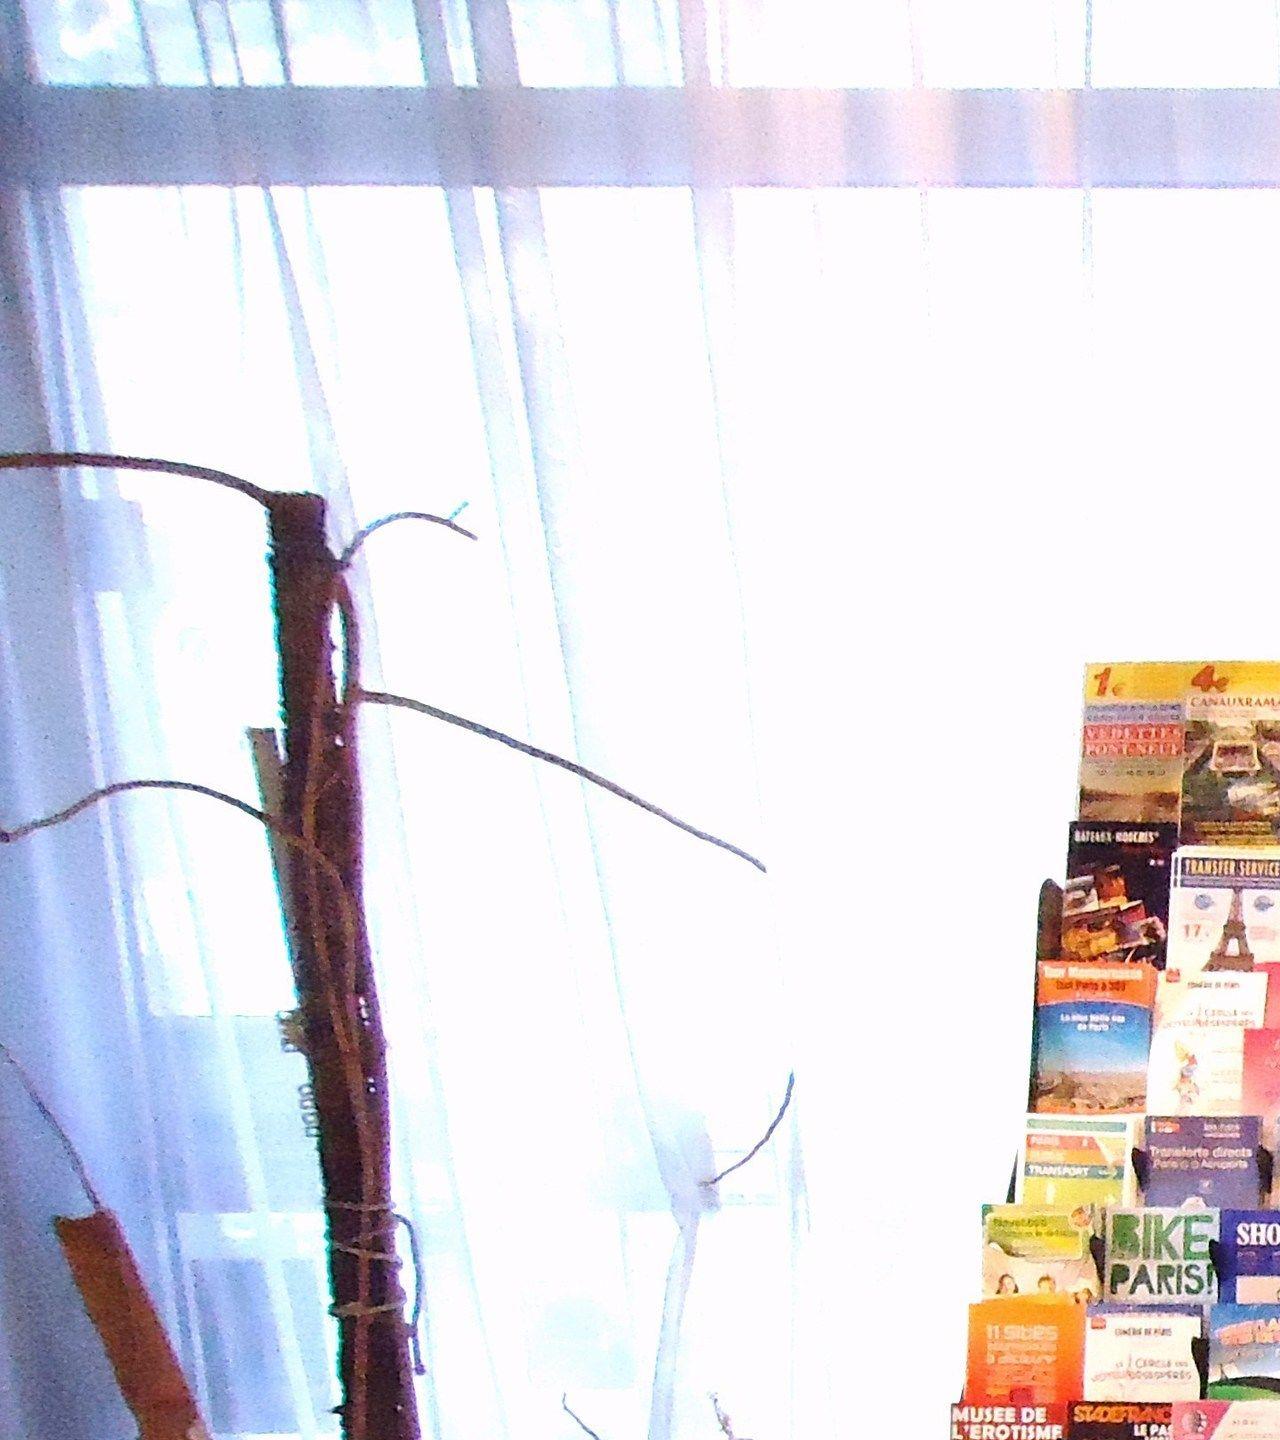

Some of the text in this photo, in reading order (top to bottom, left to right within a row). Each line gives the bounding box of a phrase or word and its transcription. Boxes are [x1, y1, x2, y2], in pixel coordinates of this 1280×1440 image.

[1186, 859, 1280, 877] TRANSFER SERVICE
[1112, 1213, 1214, 1262] BIKE
[1110, 1263, 1214, 1295] PARIS!
[1021, 1407, 1047, 1423] DE
